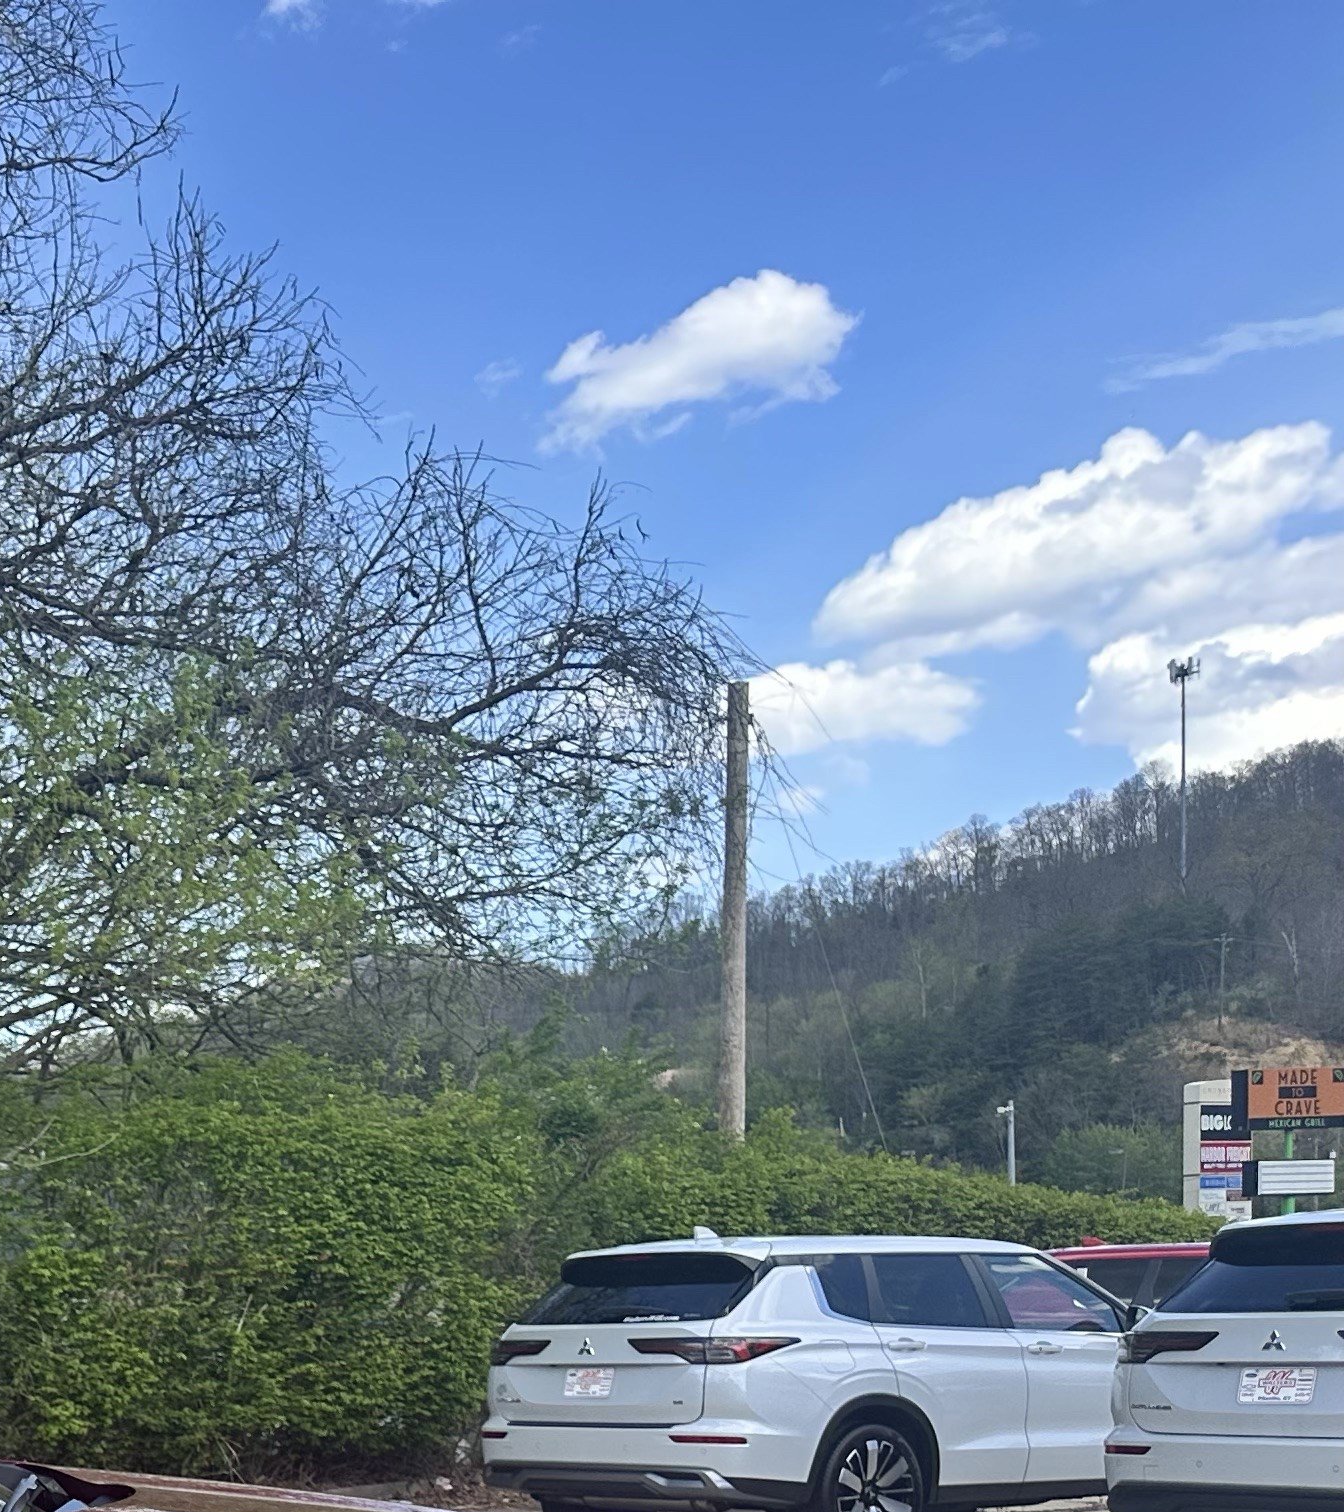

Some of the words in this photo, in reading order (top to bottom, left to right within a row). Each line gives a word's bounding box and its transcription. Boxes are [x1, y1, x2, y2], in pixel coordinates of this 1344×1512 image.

[1277, 1069, 1318, 1085] MADE
[1291, 1087, 1304, 1098] TO
[1274, 1099, 1322, 1116] CRAVE
[1268, 1118, 1302, 1129] MEXICAN
